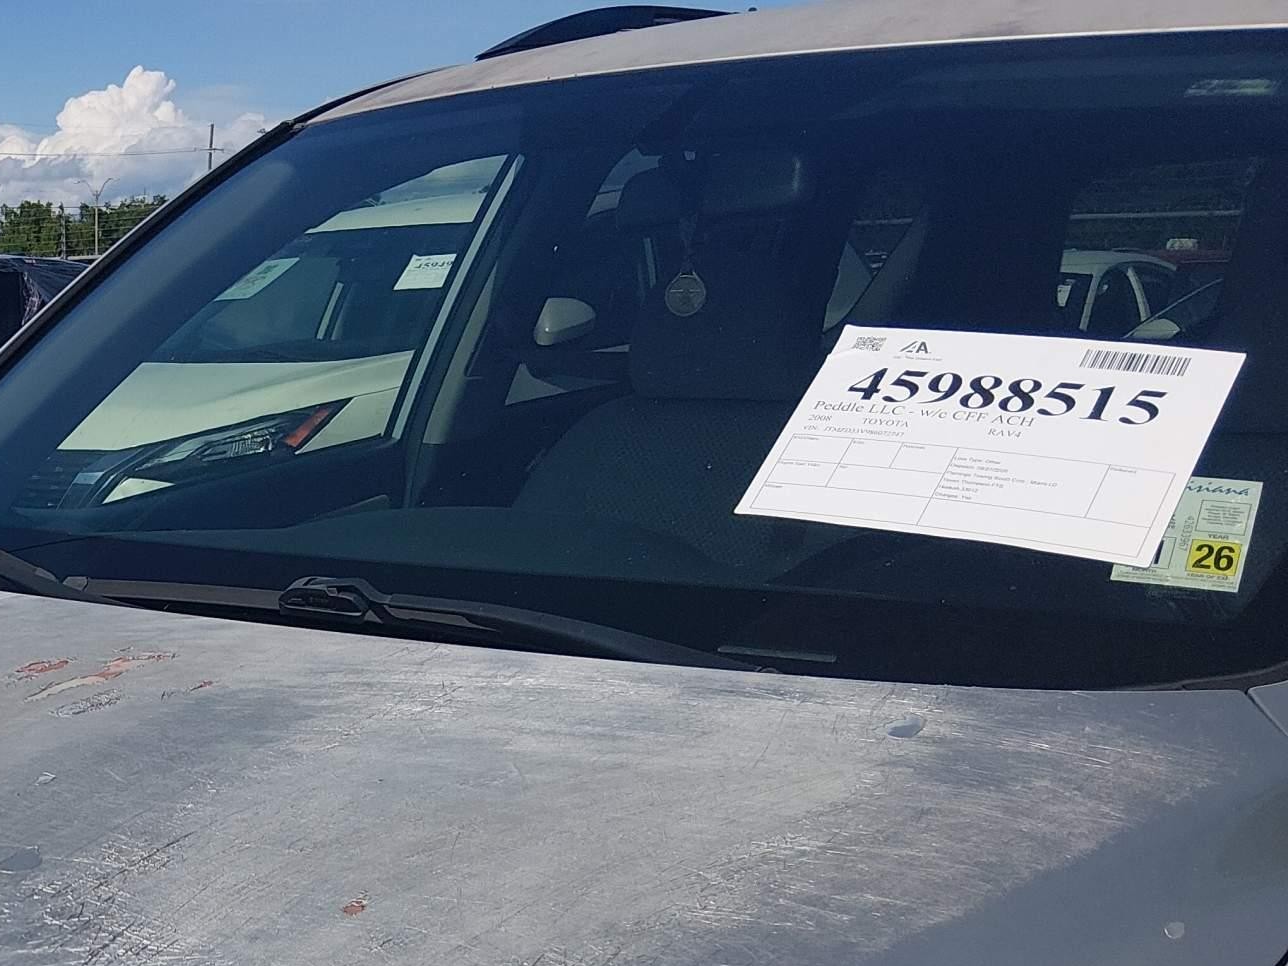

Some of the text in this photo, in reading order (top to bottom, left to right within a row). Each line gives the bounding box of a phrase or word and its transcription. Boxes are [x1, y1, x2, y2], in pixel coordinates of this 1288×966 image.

[848, 367, 1168, 425] 45988515
[808, 413, 1022, 438] 2008 TOYOTA RAV4
[813, 400, 864, 412] Peddle
[868, 404, 906, 416] LLC
[920, 404, 948, 419] w/c
[952, 411, 989, 422] CFF
[991, 415, 1035, 427] ACH
[1207, 533, 1230, 541] YEAR
[1191, 543, 1236, 572] 26
